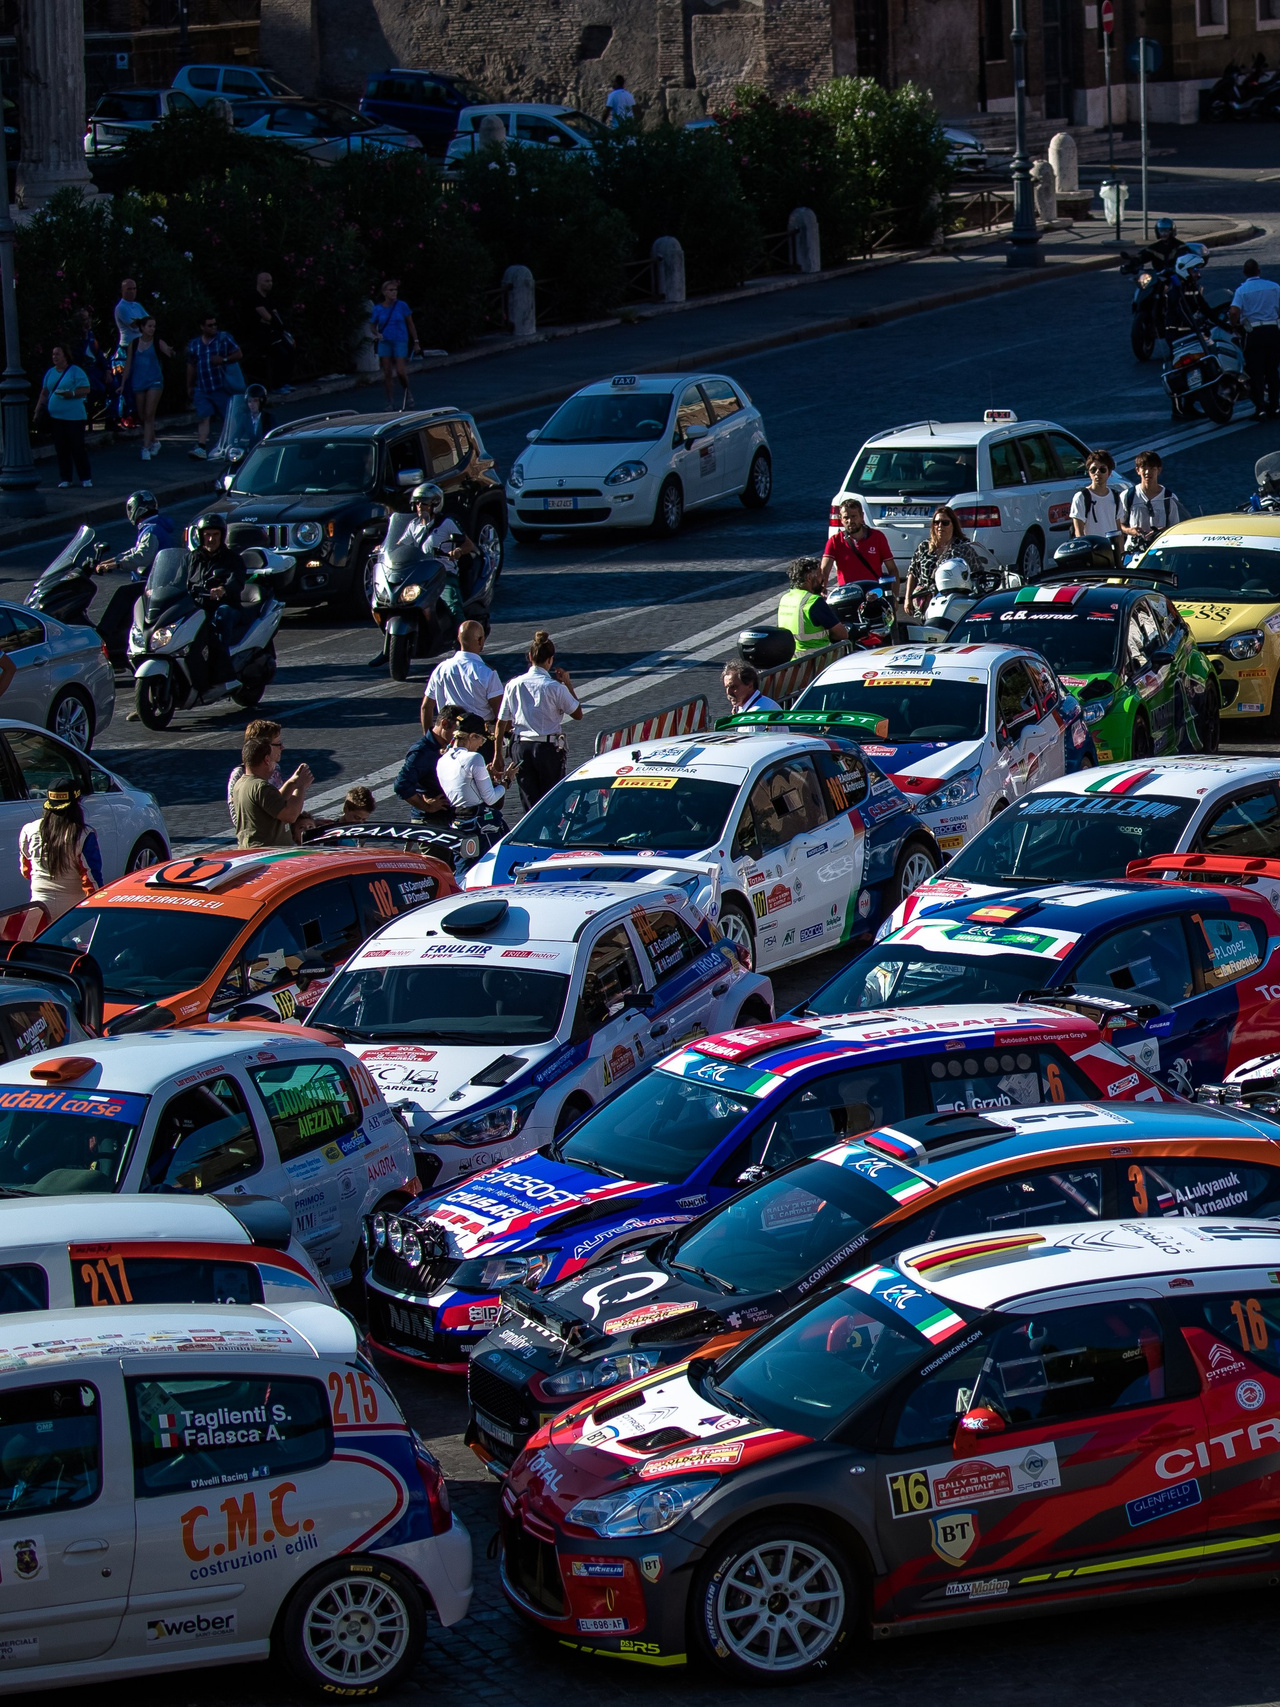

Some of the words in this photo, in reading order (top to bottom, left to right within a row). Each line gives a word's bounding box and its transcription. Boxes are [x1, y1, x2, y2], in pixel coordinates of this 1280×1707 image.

[612, 376, 636, 385] TAXI
[1237, 669, 1267, 678] PIRELLI
[620, 778, 672, 787] PIRELLI
[934, 822, 966, 834] sparco
[748, 873, 765, 885] TOTAL
[369, 878, 400, 918] 102
[800, 924, 824, 941] sparco
[420, 952, 452, 960] Dryers
[425, 944, 493, 957] FRIULAIR
[1213, 939, 1246, 961] P.Lopez
[862, 1017, 1008, 1040] CRUSAR
[695, 1041, 740, 1058] CRUSAR
[1047, 1063, 1066, 1101] 6
[61, 1096, 123, 1117] corse
[298, 1110, 332, 1139] AIEZZA
[366, 1156, 397, 1182] AMBRA
[1127, 1163, 1148, 1214] 3
[1176, 1172, 1240, 1202] A.Lukyanuk
[294, 1192, 325, 1210] PRIMOS
[295, 1216, 314, 1233] MM
[796, 1233, 869, 1295] FB.COM/LUKYANUK
[81, 1253, 135, 1305] 217
[1230, 1298, 1269, 1352] 16
[498, 1327, 537, 1360] simplifying
[919, 1330, 984, 1377] CITROENRACING.COM
[1206, 1361, 1245, 1379] CITROËN
[328, 1371, 379, 1426] 215
[36, 1422, 54, 1432] OMP
[181, 1407, 269, 1434] Taglienti
[271, 1405, 292, 1421] S.
[184, 1426, 260, 1448] Falasca
[265, 1423, 286, 1442] A.
[524, 1449, 558, 1493] TOTAL
[648, 1454, 731, 1473] COMPETITOR
[191, 1475, 221, 1490] D'Avelli
[221, 1471, 249, 1486] Racing
[937, 1479, 967, 1494] RALLY
[980, 1471, 1007, 1486] ROMA
[952, 1481, 995, 1497] CAPITALE
[1017, 1477, 1057, 1492] SPORT
[894, 1473, 932, 1516] 16
[1132, 1482, 1191, 1513] GLENFIELD
[180, 1481, 316, 1563] C.M.C.
[941, 1521, 970, 1544] BT
[190, 1548, 278, 1582] costruzioni
[285, 1533, 320, 1557] edili
[642, 1559, 657, 1574] BT
[587, 1565, 623, 1575] MICHELIN
[165, 1614, 235, 1636] weber
[195, 1628, 236, 1640] SAINT-GOBAIN
[618, 1639, 632, 1650] DS3
[632, 1640, 660, 1656] R5
